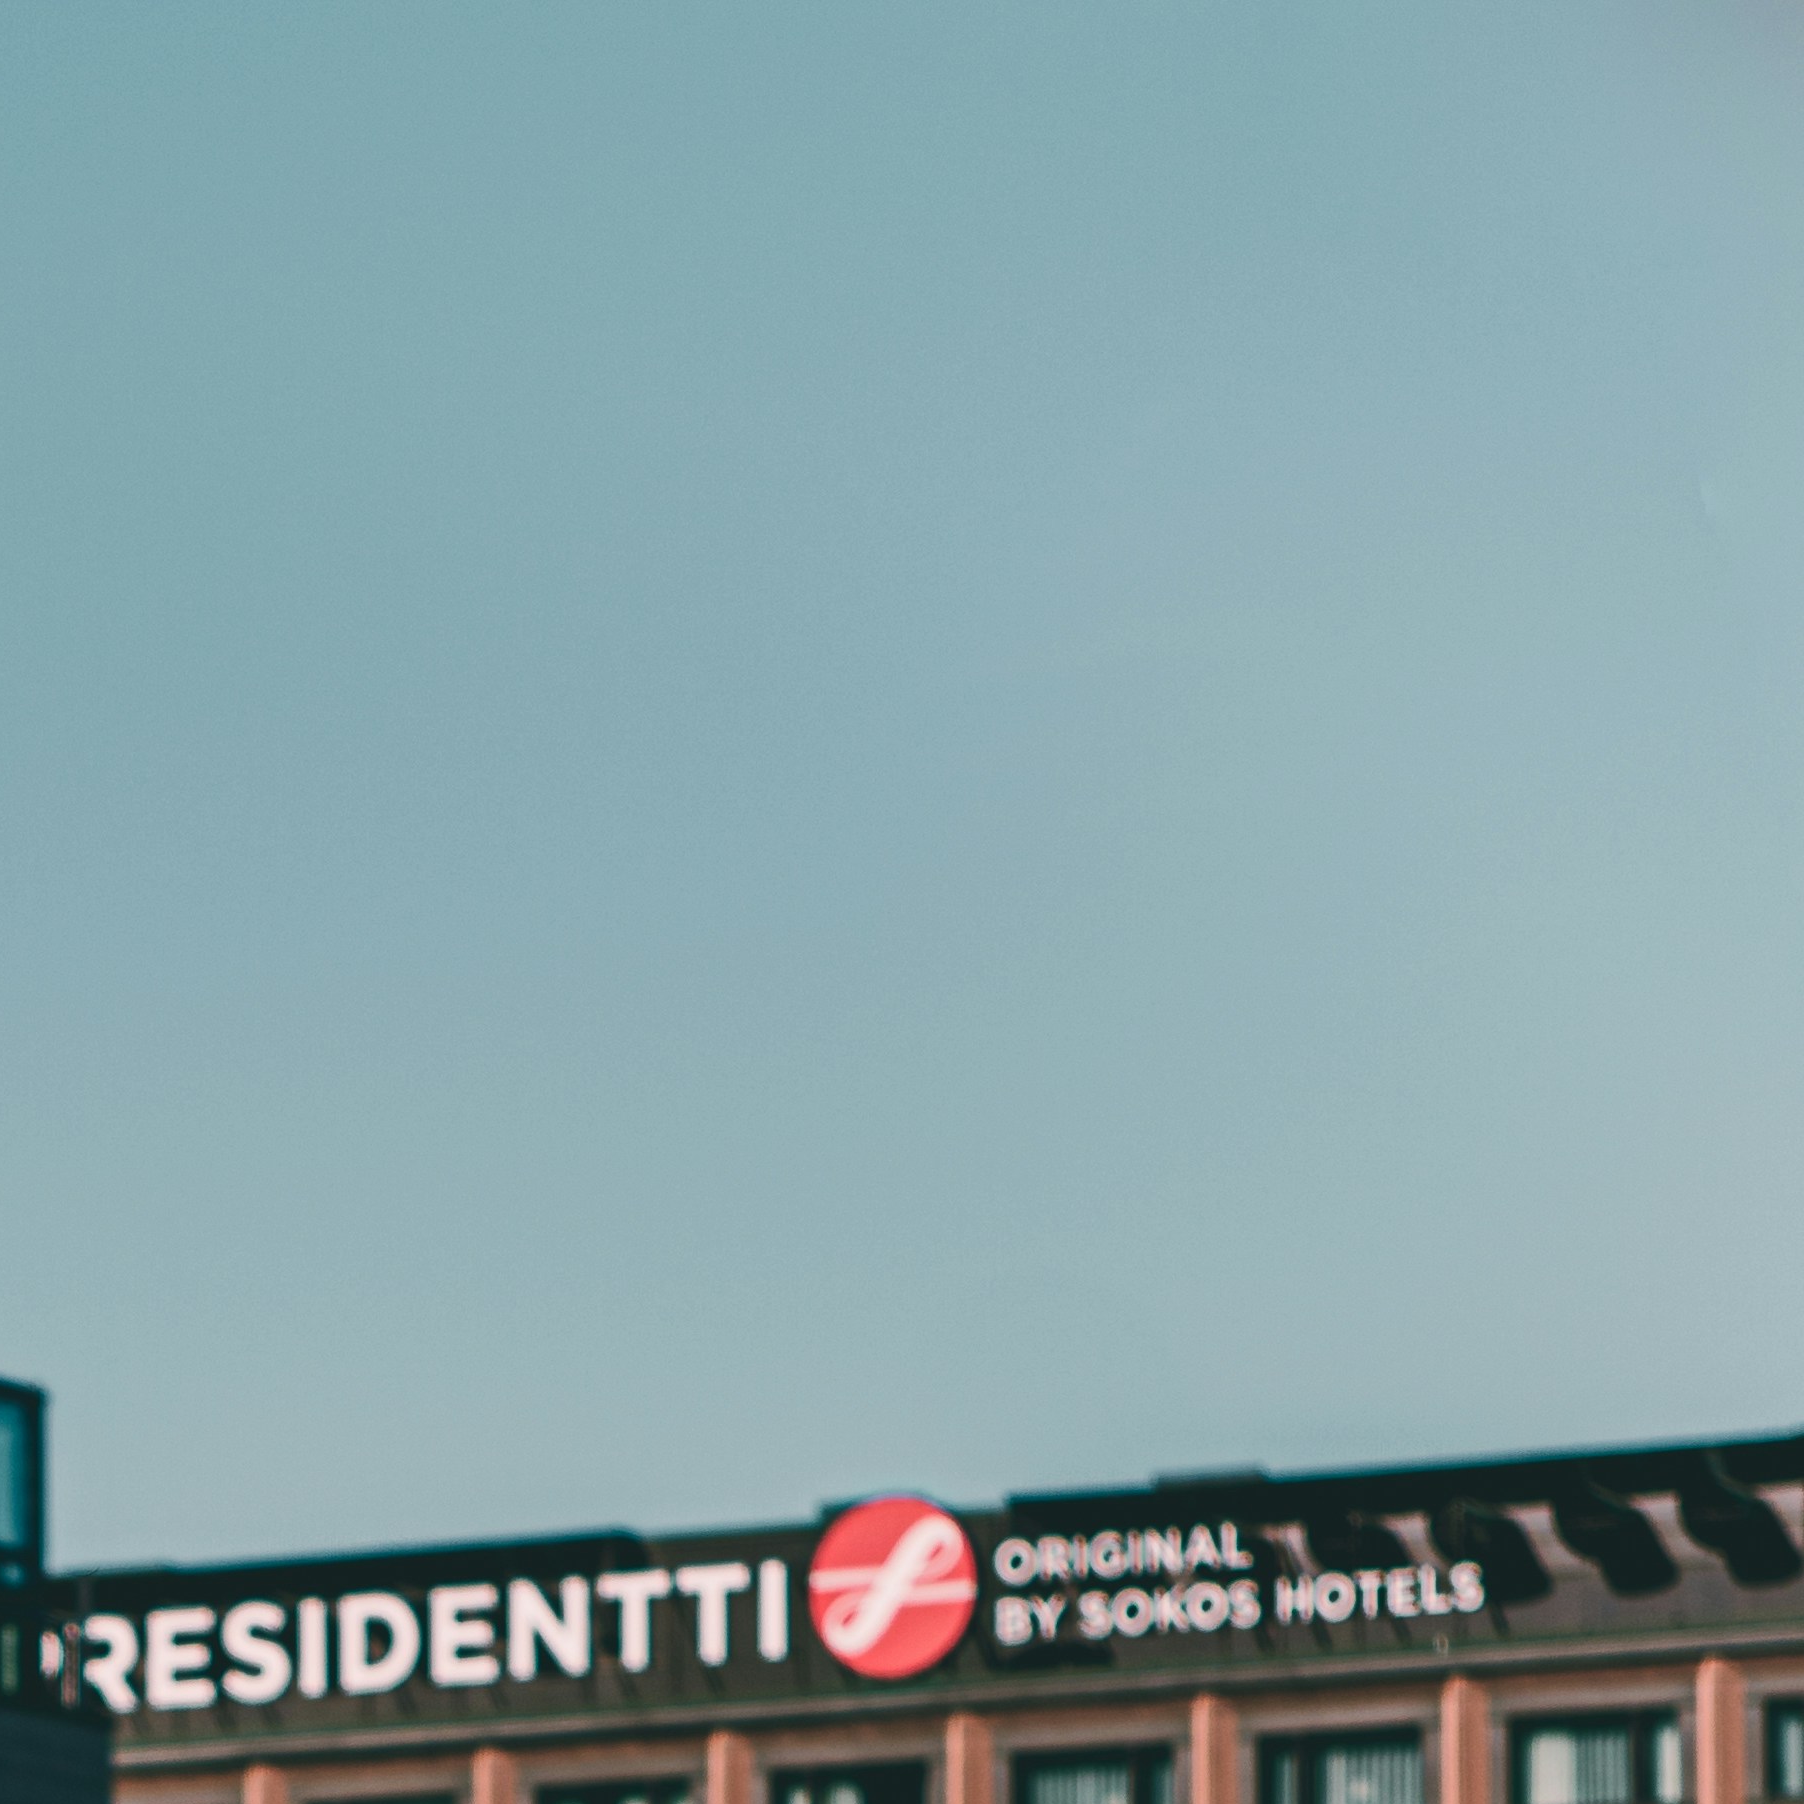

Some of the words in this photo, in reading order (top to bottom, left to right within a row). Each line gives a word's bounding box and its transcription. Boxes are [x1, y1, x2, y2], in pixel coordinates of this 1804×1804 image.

[995, 1521, 1254, 1587] ORIGINAL
[995, 1596, 1064, 1646] BY
[1078, 1578, 1261, 1637] SOKOS
[1275, 1561, 1484, 1626] HOTELS
